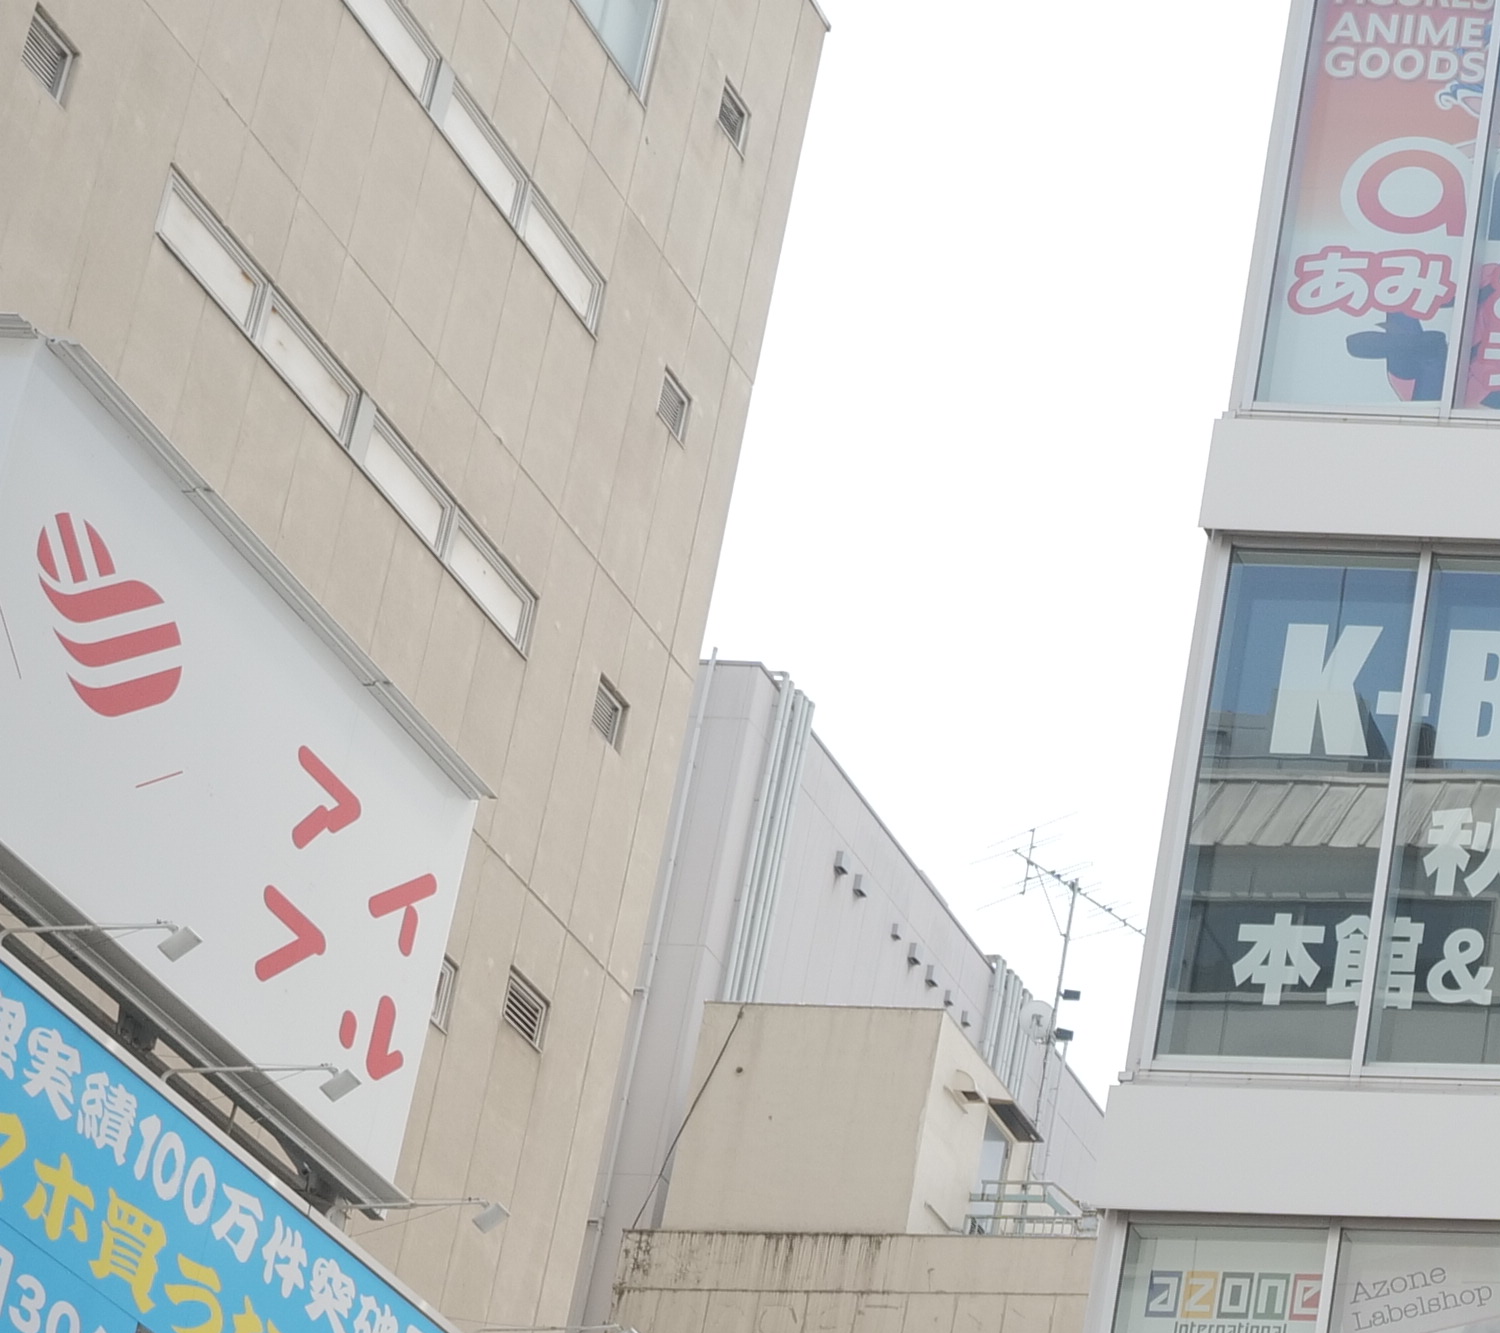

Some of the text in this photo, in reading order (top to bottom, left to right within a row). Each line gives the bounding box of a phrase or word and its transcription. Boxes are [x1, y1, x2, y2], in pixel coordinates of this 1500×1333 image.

[1326, 11, 1486, 49] ANIME
[1324, 46, 1486, 83] GOODS
[1145, 1269, 1324, 1322] azone
[1349, 1266, 1448, 1305] Azone
[1352, 1280, 1495, 1332] Labelshop
